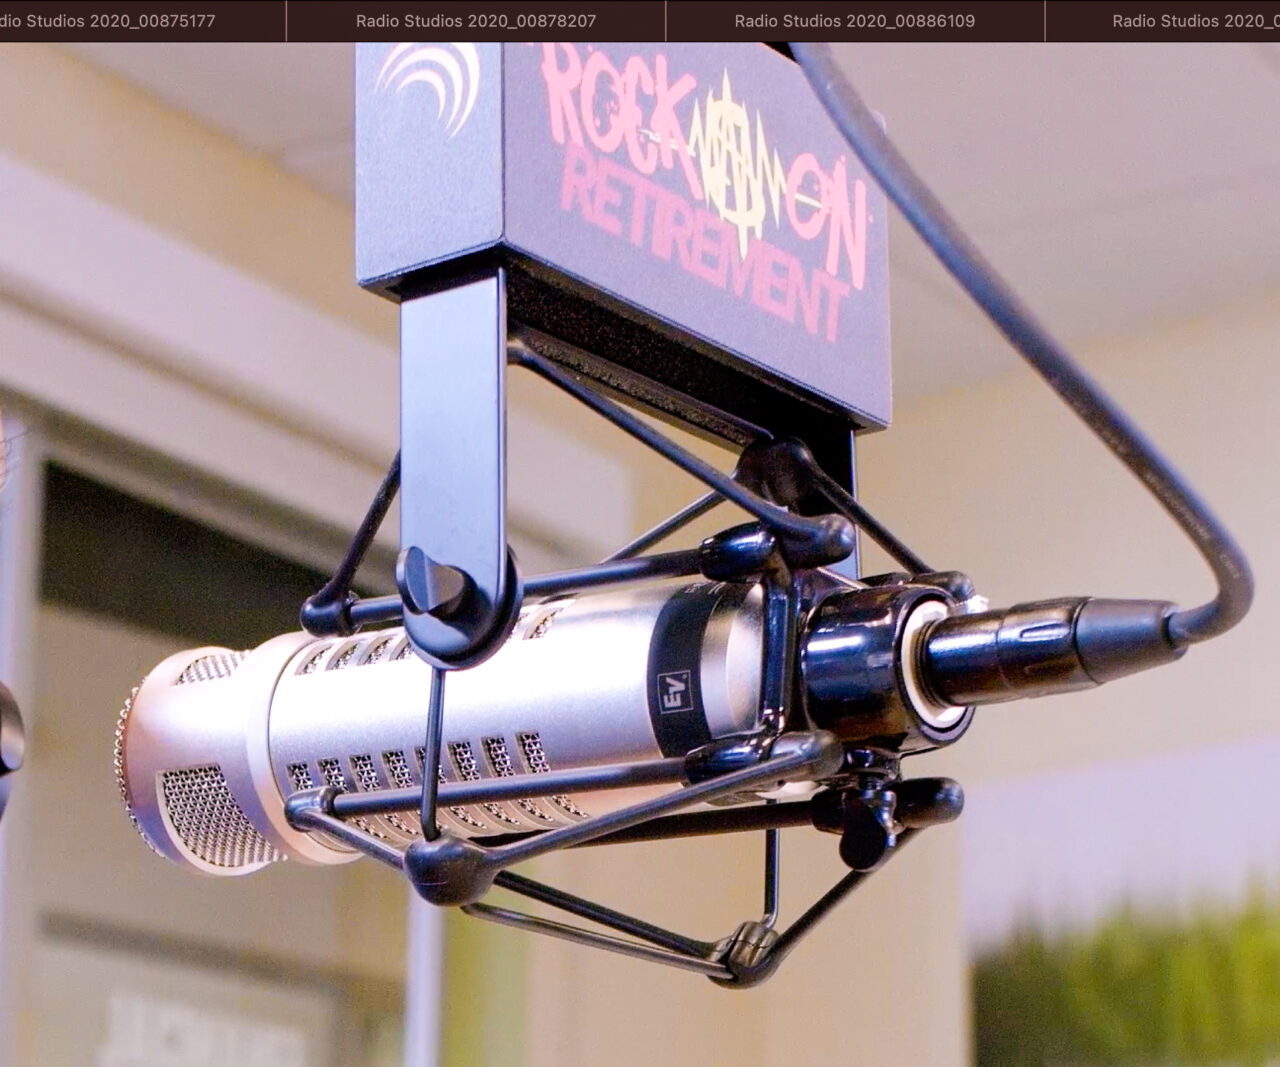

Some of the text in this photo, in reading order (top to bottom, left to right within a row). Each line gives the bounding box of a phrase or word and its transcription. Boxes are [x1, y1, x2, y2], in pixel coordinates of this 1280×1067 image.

[541, 42, 868, 291] ROCK ON
[560, 143, 851, 344] RETIREMENT
